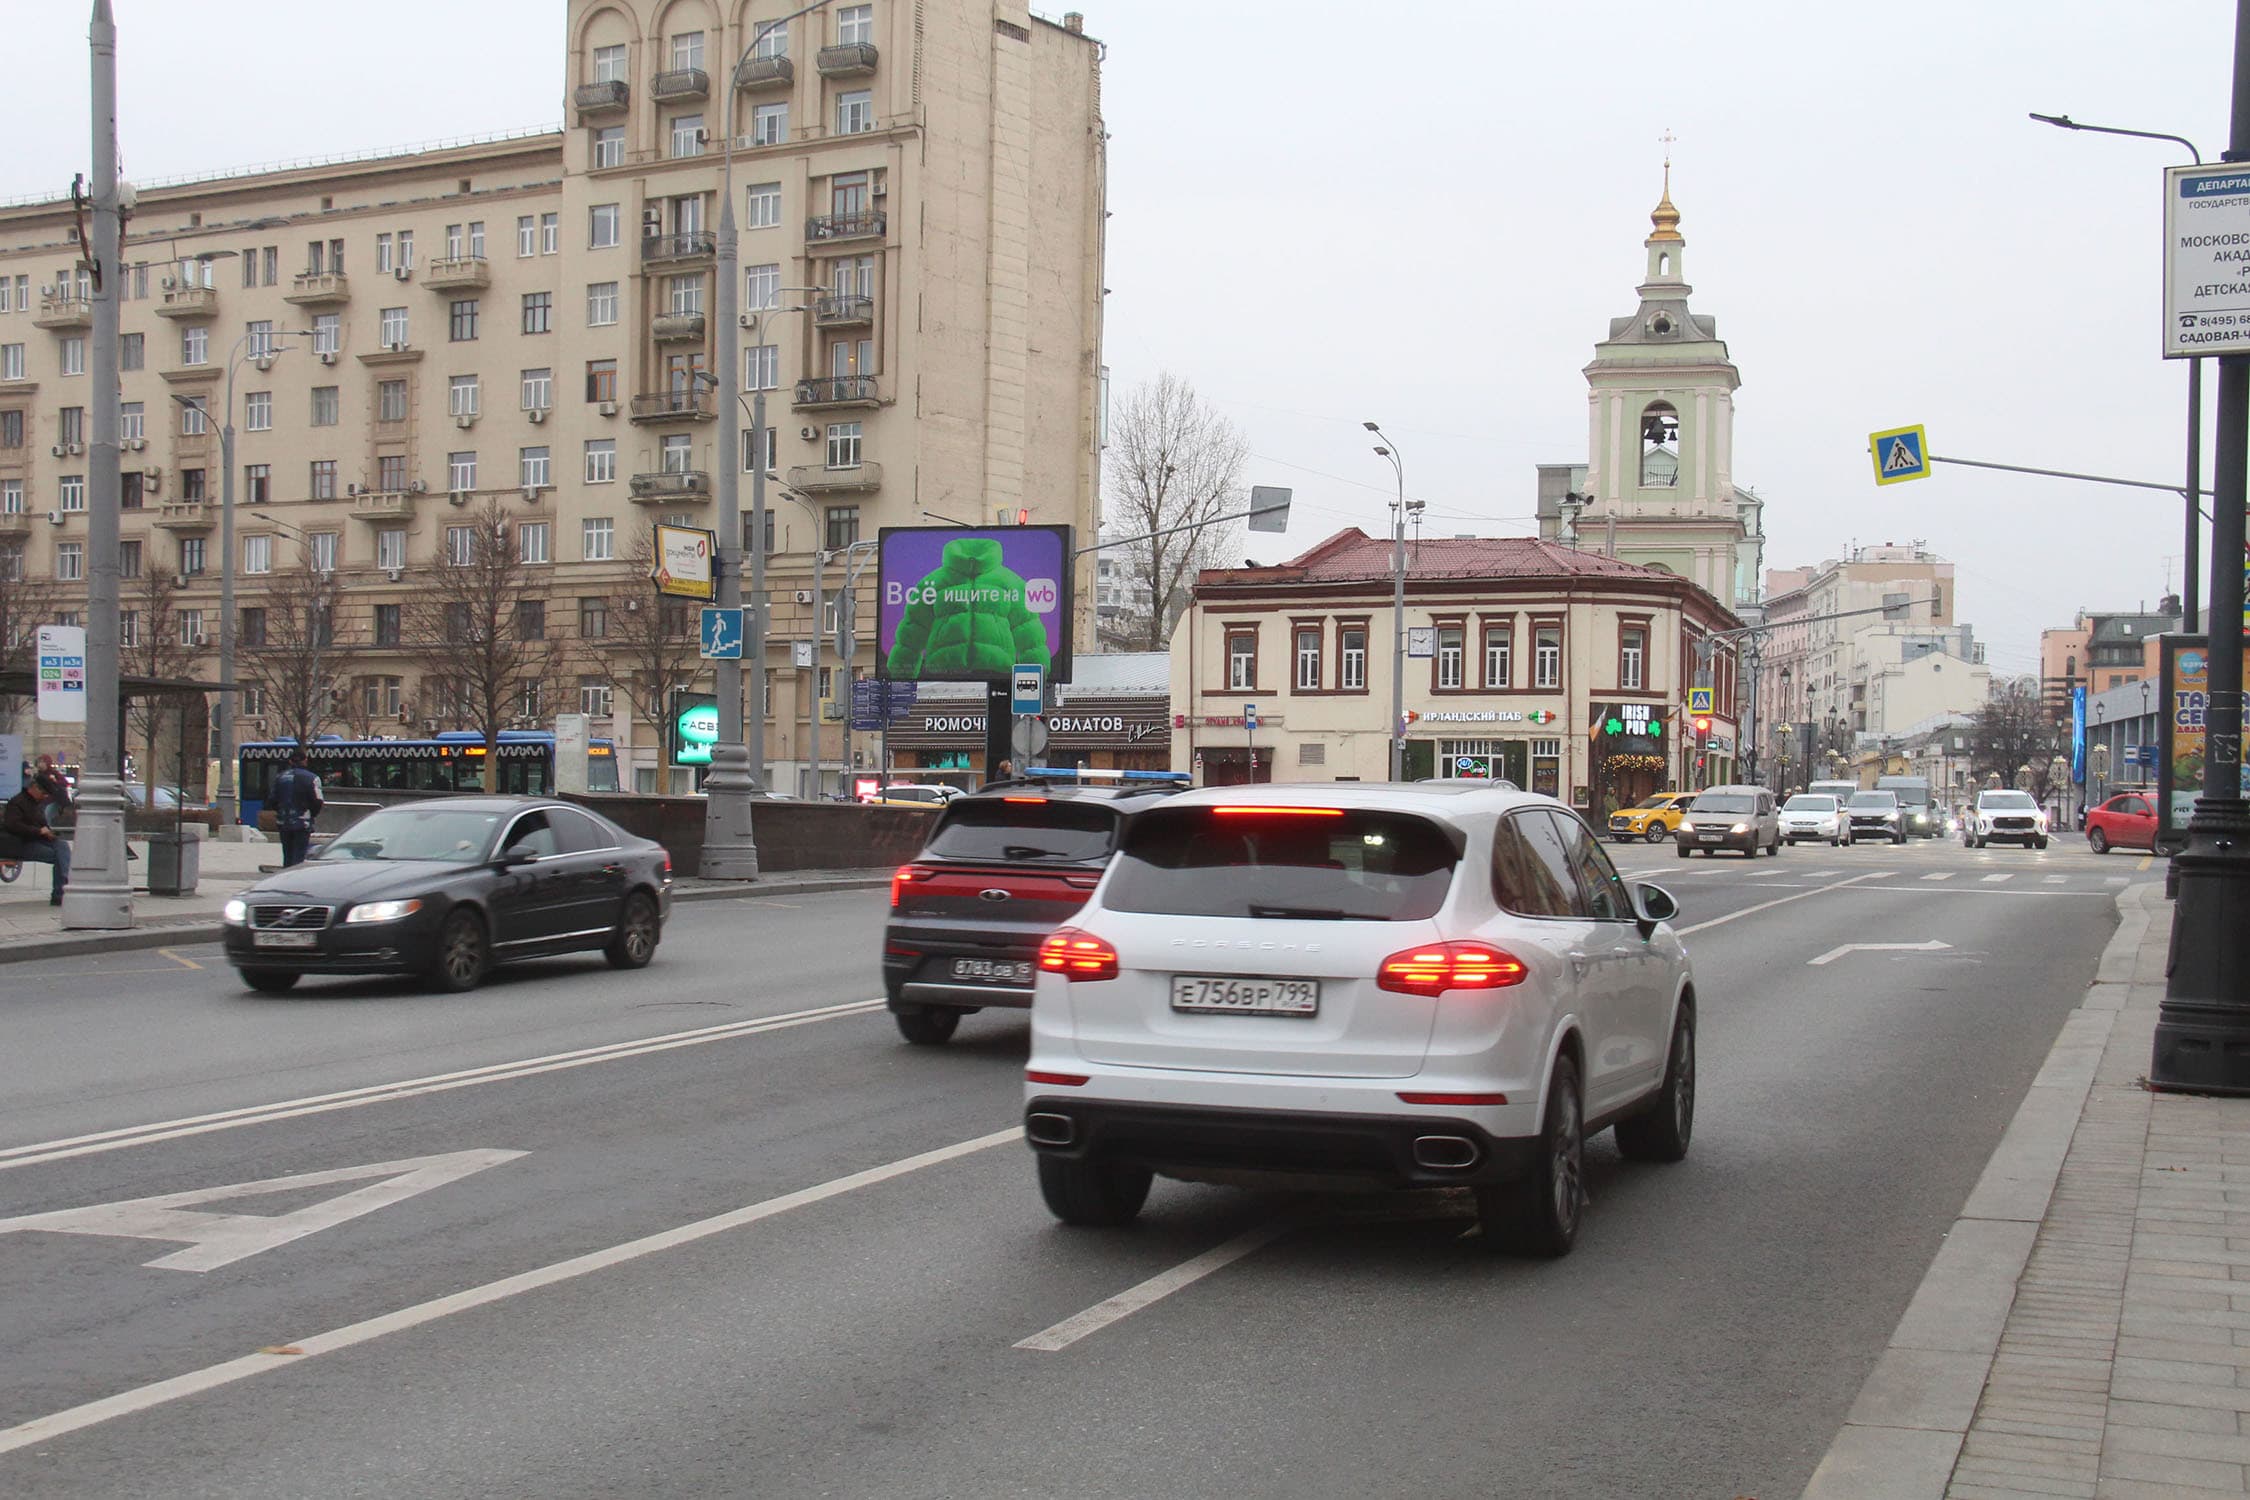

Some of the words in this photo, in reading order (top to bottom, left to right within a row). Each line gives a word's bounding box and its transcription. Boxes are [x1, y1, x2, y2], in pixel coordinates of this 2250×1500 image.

[887, 581, 937, 605] Всё
[944, 589, 1000, 604] ищите
[1003, 588, 1020, 602] на
[1423, 711, 1496, 722] ИРЛАНДСКИЙ
[1498, 712, 1522, 721] ПАБ
[1621, 704, 1650, 720] IRISH
[925, 717, 986, 731] РЮМОЧ
[1626, 721, 1646, 735] PUB
